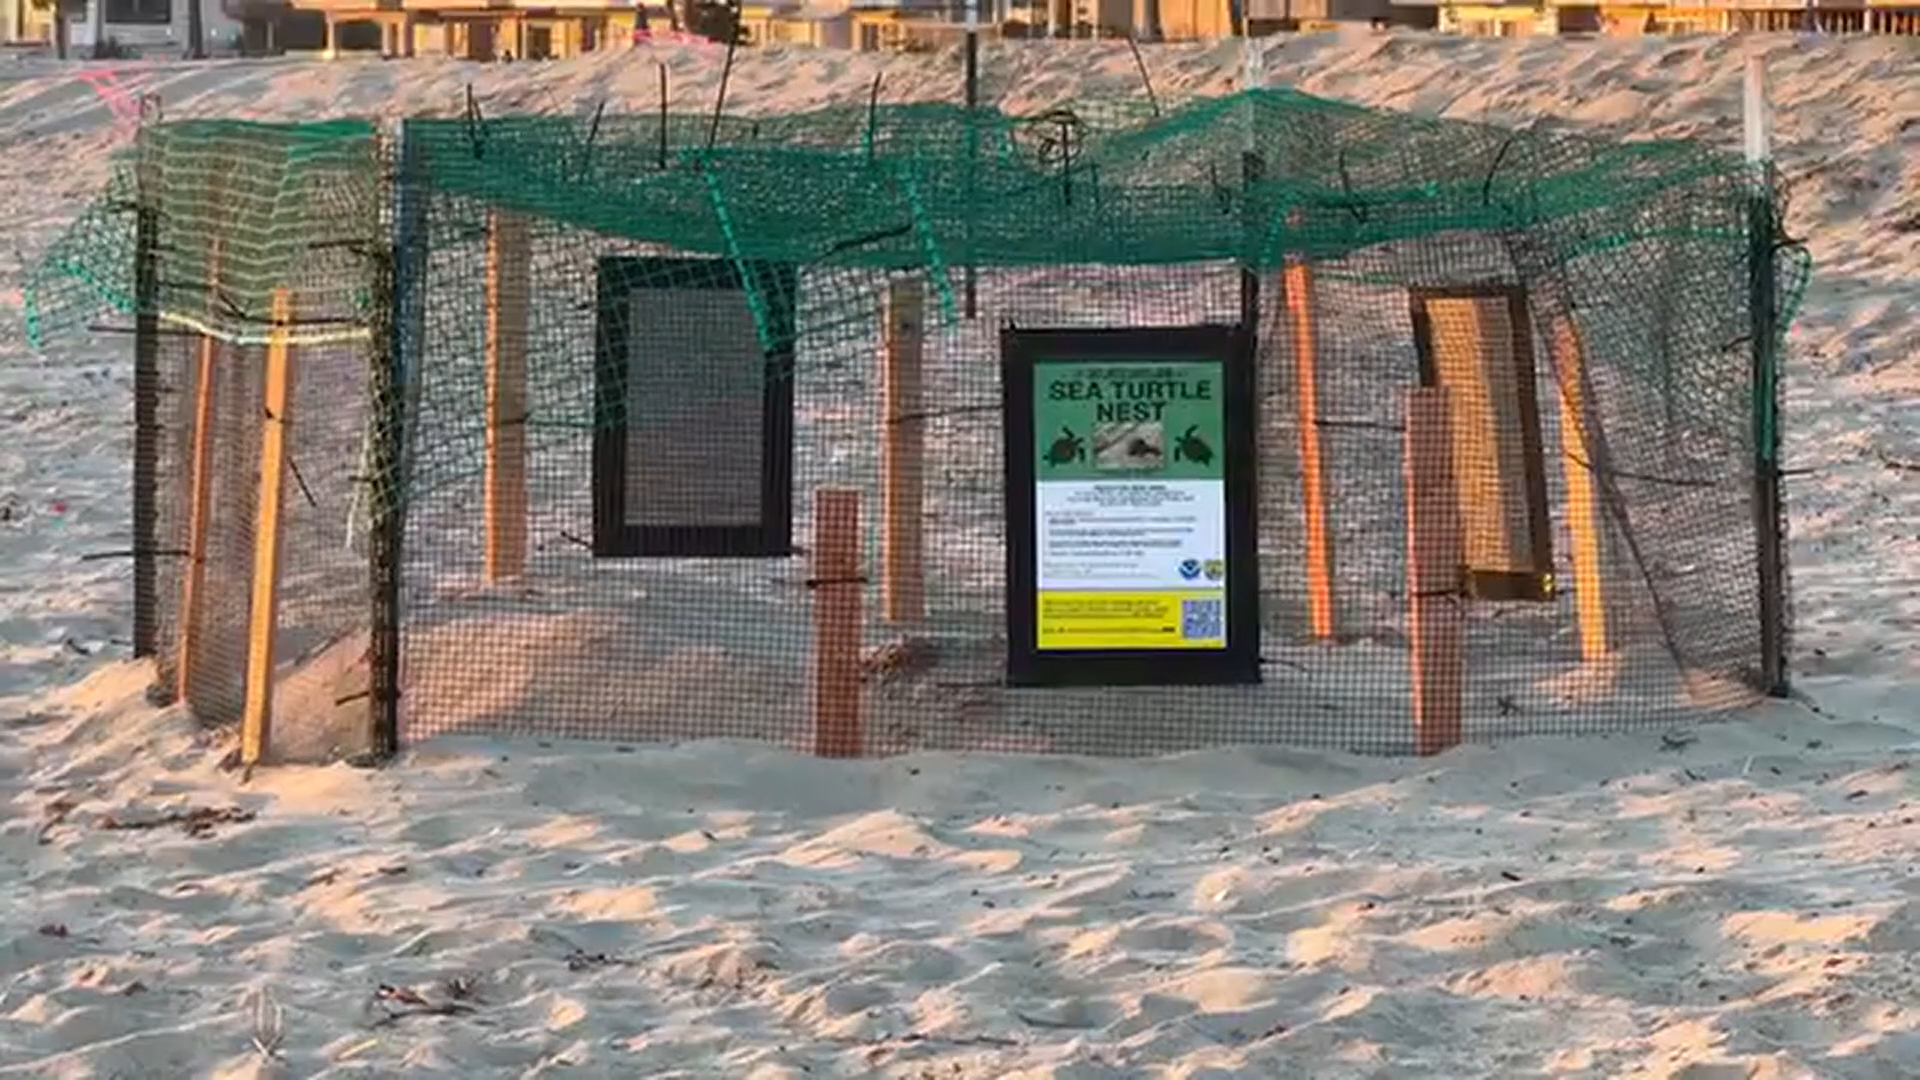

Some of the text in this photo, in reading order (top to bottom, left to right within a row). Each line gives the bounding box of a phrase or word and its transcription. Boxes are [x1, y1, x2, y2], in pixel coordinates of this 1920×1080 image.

[1049, 380, 1211, 400] SEA TURTLE
[1097, 402, 1166, 422] NEST
